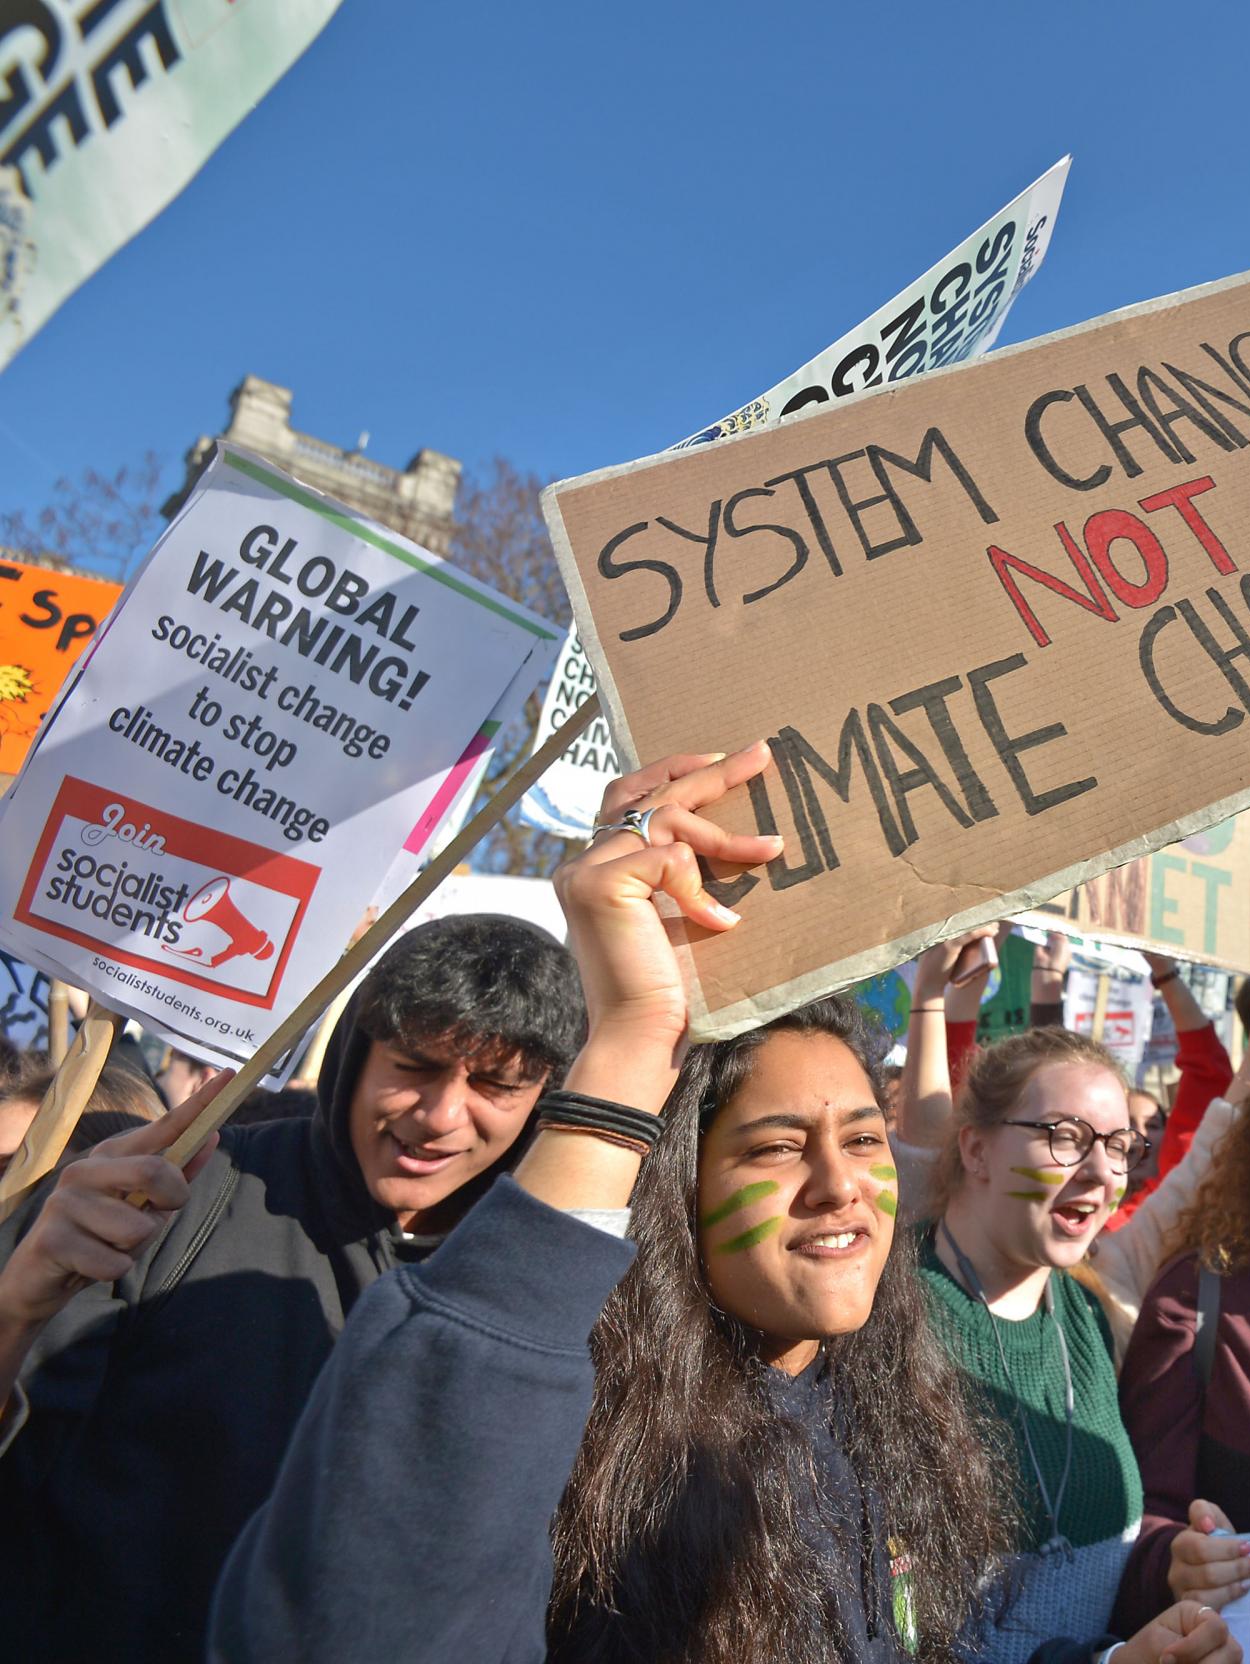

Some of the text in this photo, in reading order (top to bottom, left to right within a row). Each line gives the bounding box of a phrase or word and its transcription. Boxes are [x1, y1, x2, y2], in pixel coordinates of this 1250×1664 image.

[239, 524, 420, 653] GLOBAL
[598, 427, 1000, 642] SYSTEM
[986, 475, 1239, 648] NOT
[151, 615, 391, 760] socialist change
[186, 550, 431, 712] WARNING!
[108, 705, 330, 843] climate change
[187, 686, 298, 772] to stop
[56, 848, 189, 914] socialist
[81, 803, 167, 857] Join
[46, 874, 185, 945] students
[92, 956, 256, 1042] socialiststudents.org.uk
